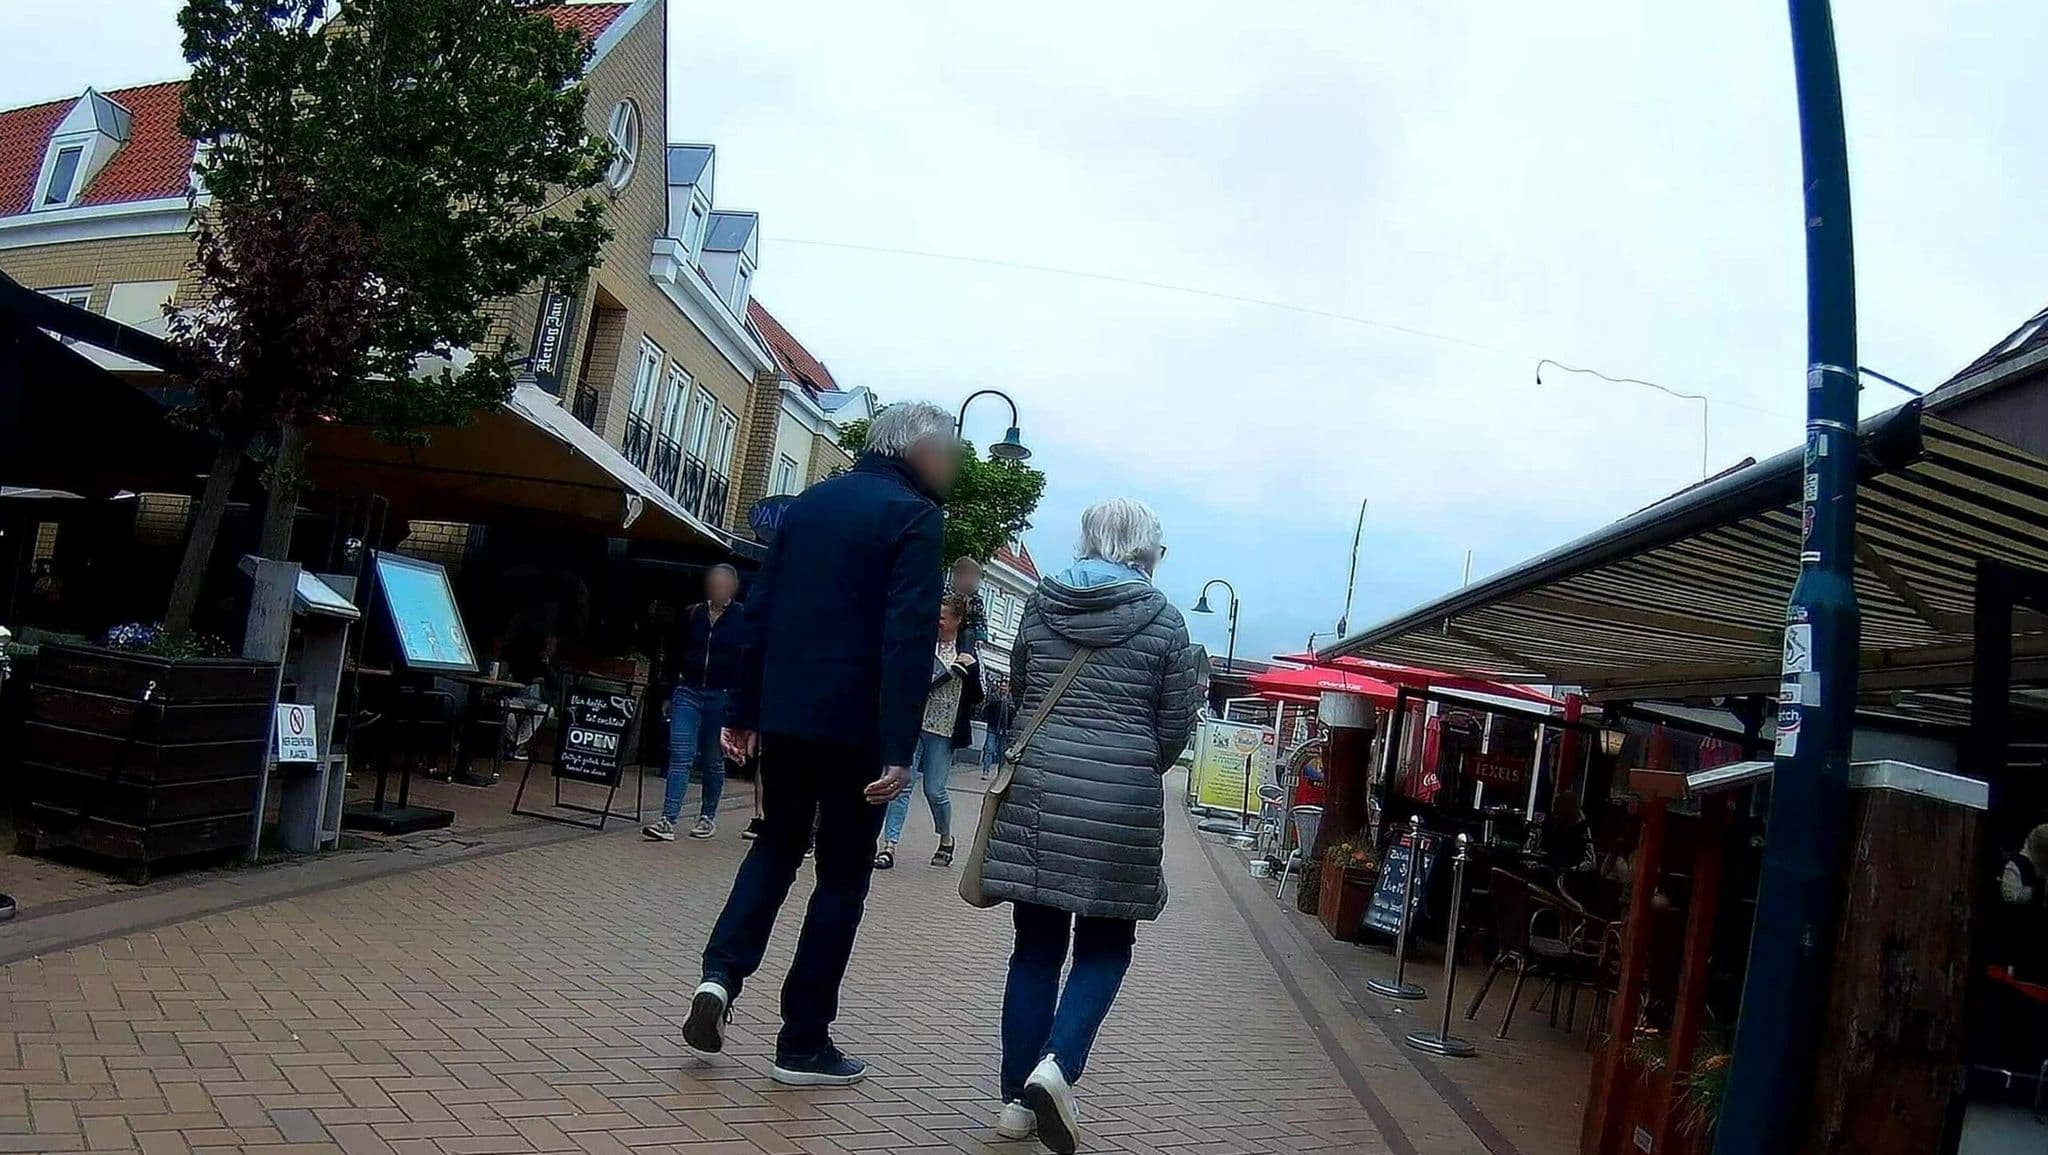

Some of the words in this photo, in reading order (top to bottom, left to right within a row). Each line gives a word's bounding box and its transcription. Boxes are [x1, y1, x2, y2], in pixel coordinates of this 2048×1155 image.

[546, 302, 564, 328] Jan
[536, 327, 559, 373] Hertog
[570, 730, 616, 750] OPEN
[1474, 758, 1521, 783] TEXELS
